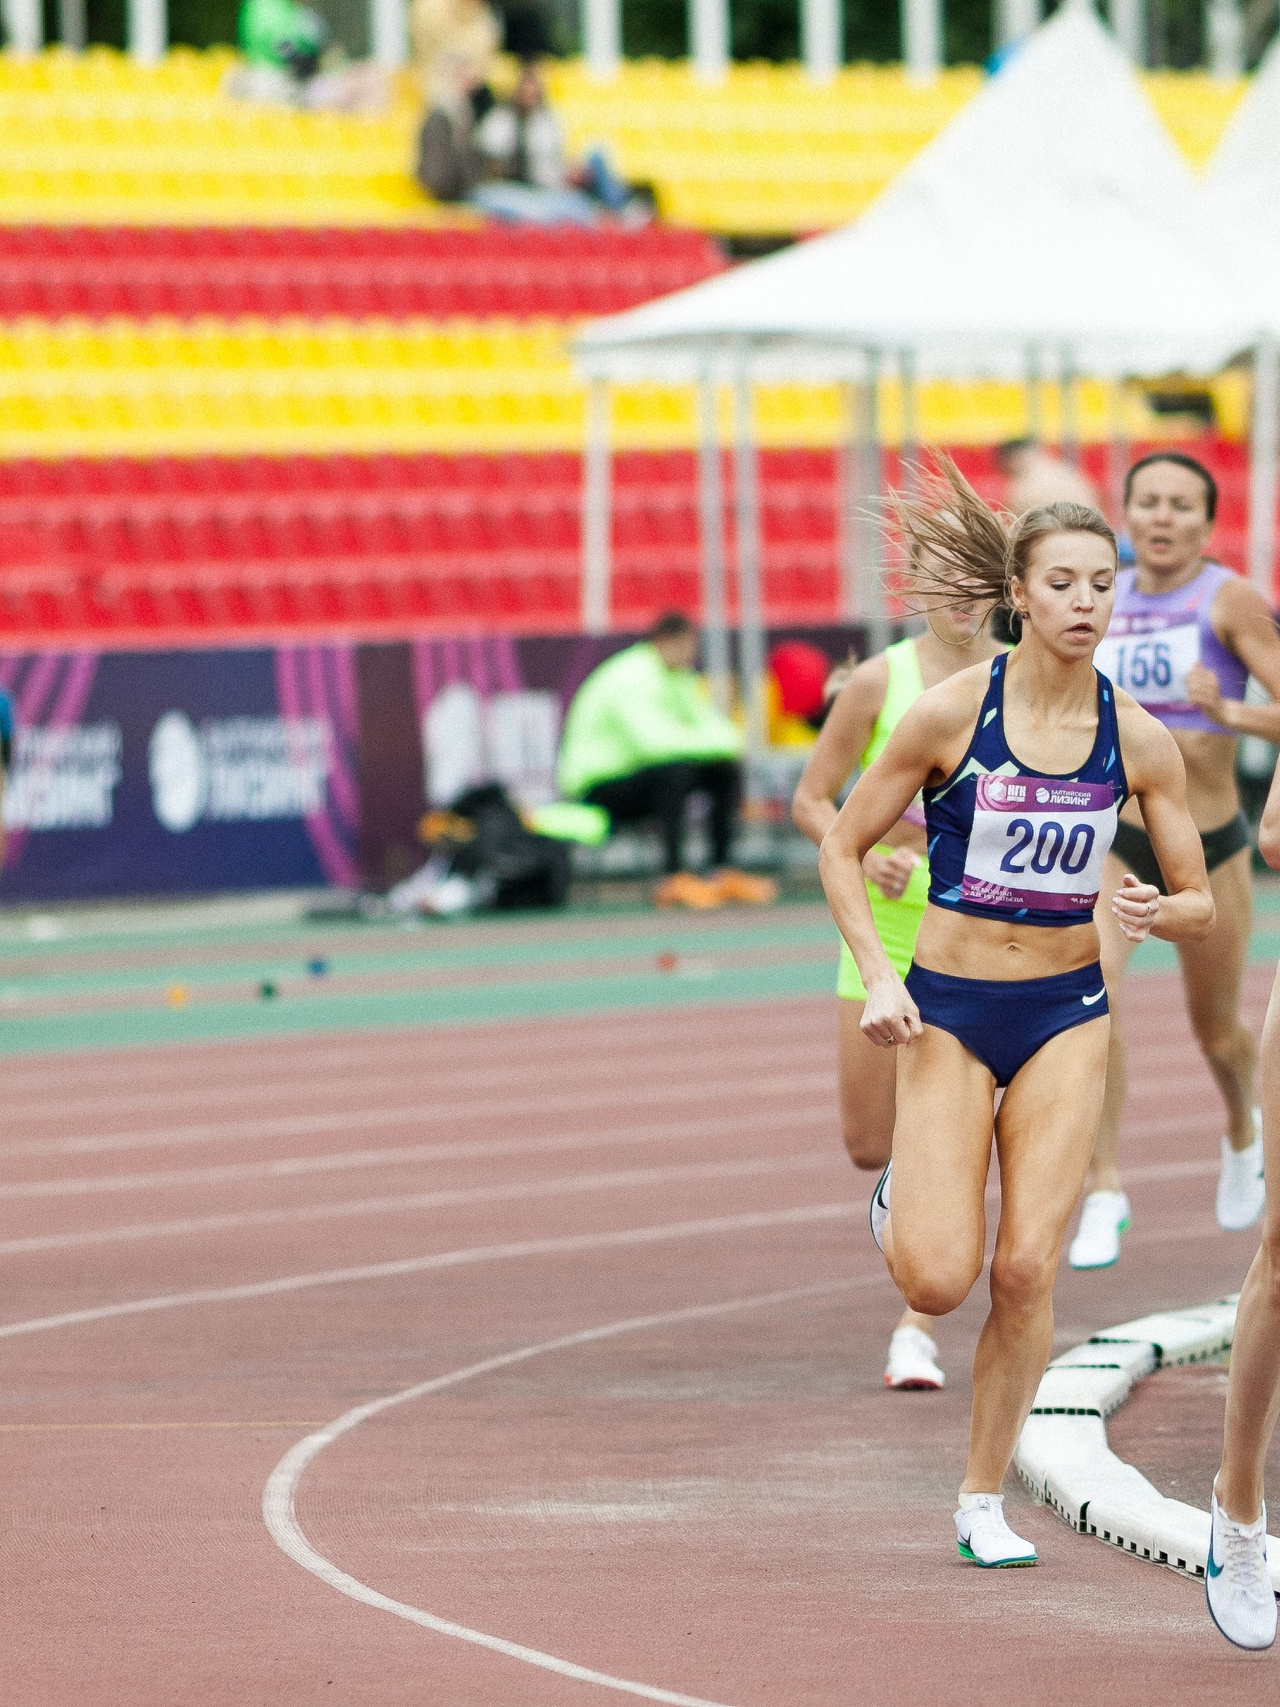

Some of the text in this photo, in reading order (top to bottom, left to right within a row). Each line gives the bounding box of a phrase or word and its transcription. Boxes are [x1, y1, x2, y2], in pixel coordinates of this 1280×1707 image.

[1117, 642, 1172, 688] 156
[1049, 795, 1091, 806] ЛИЗИНГ
[1000, 818, 1095, 875] 200
